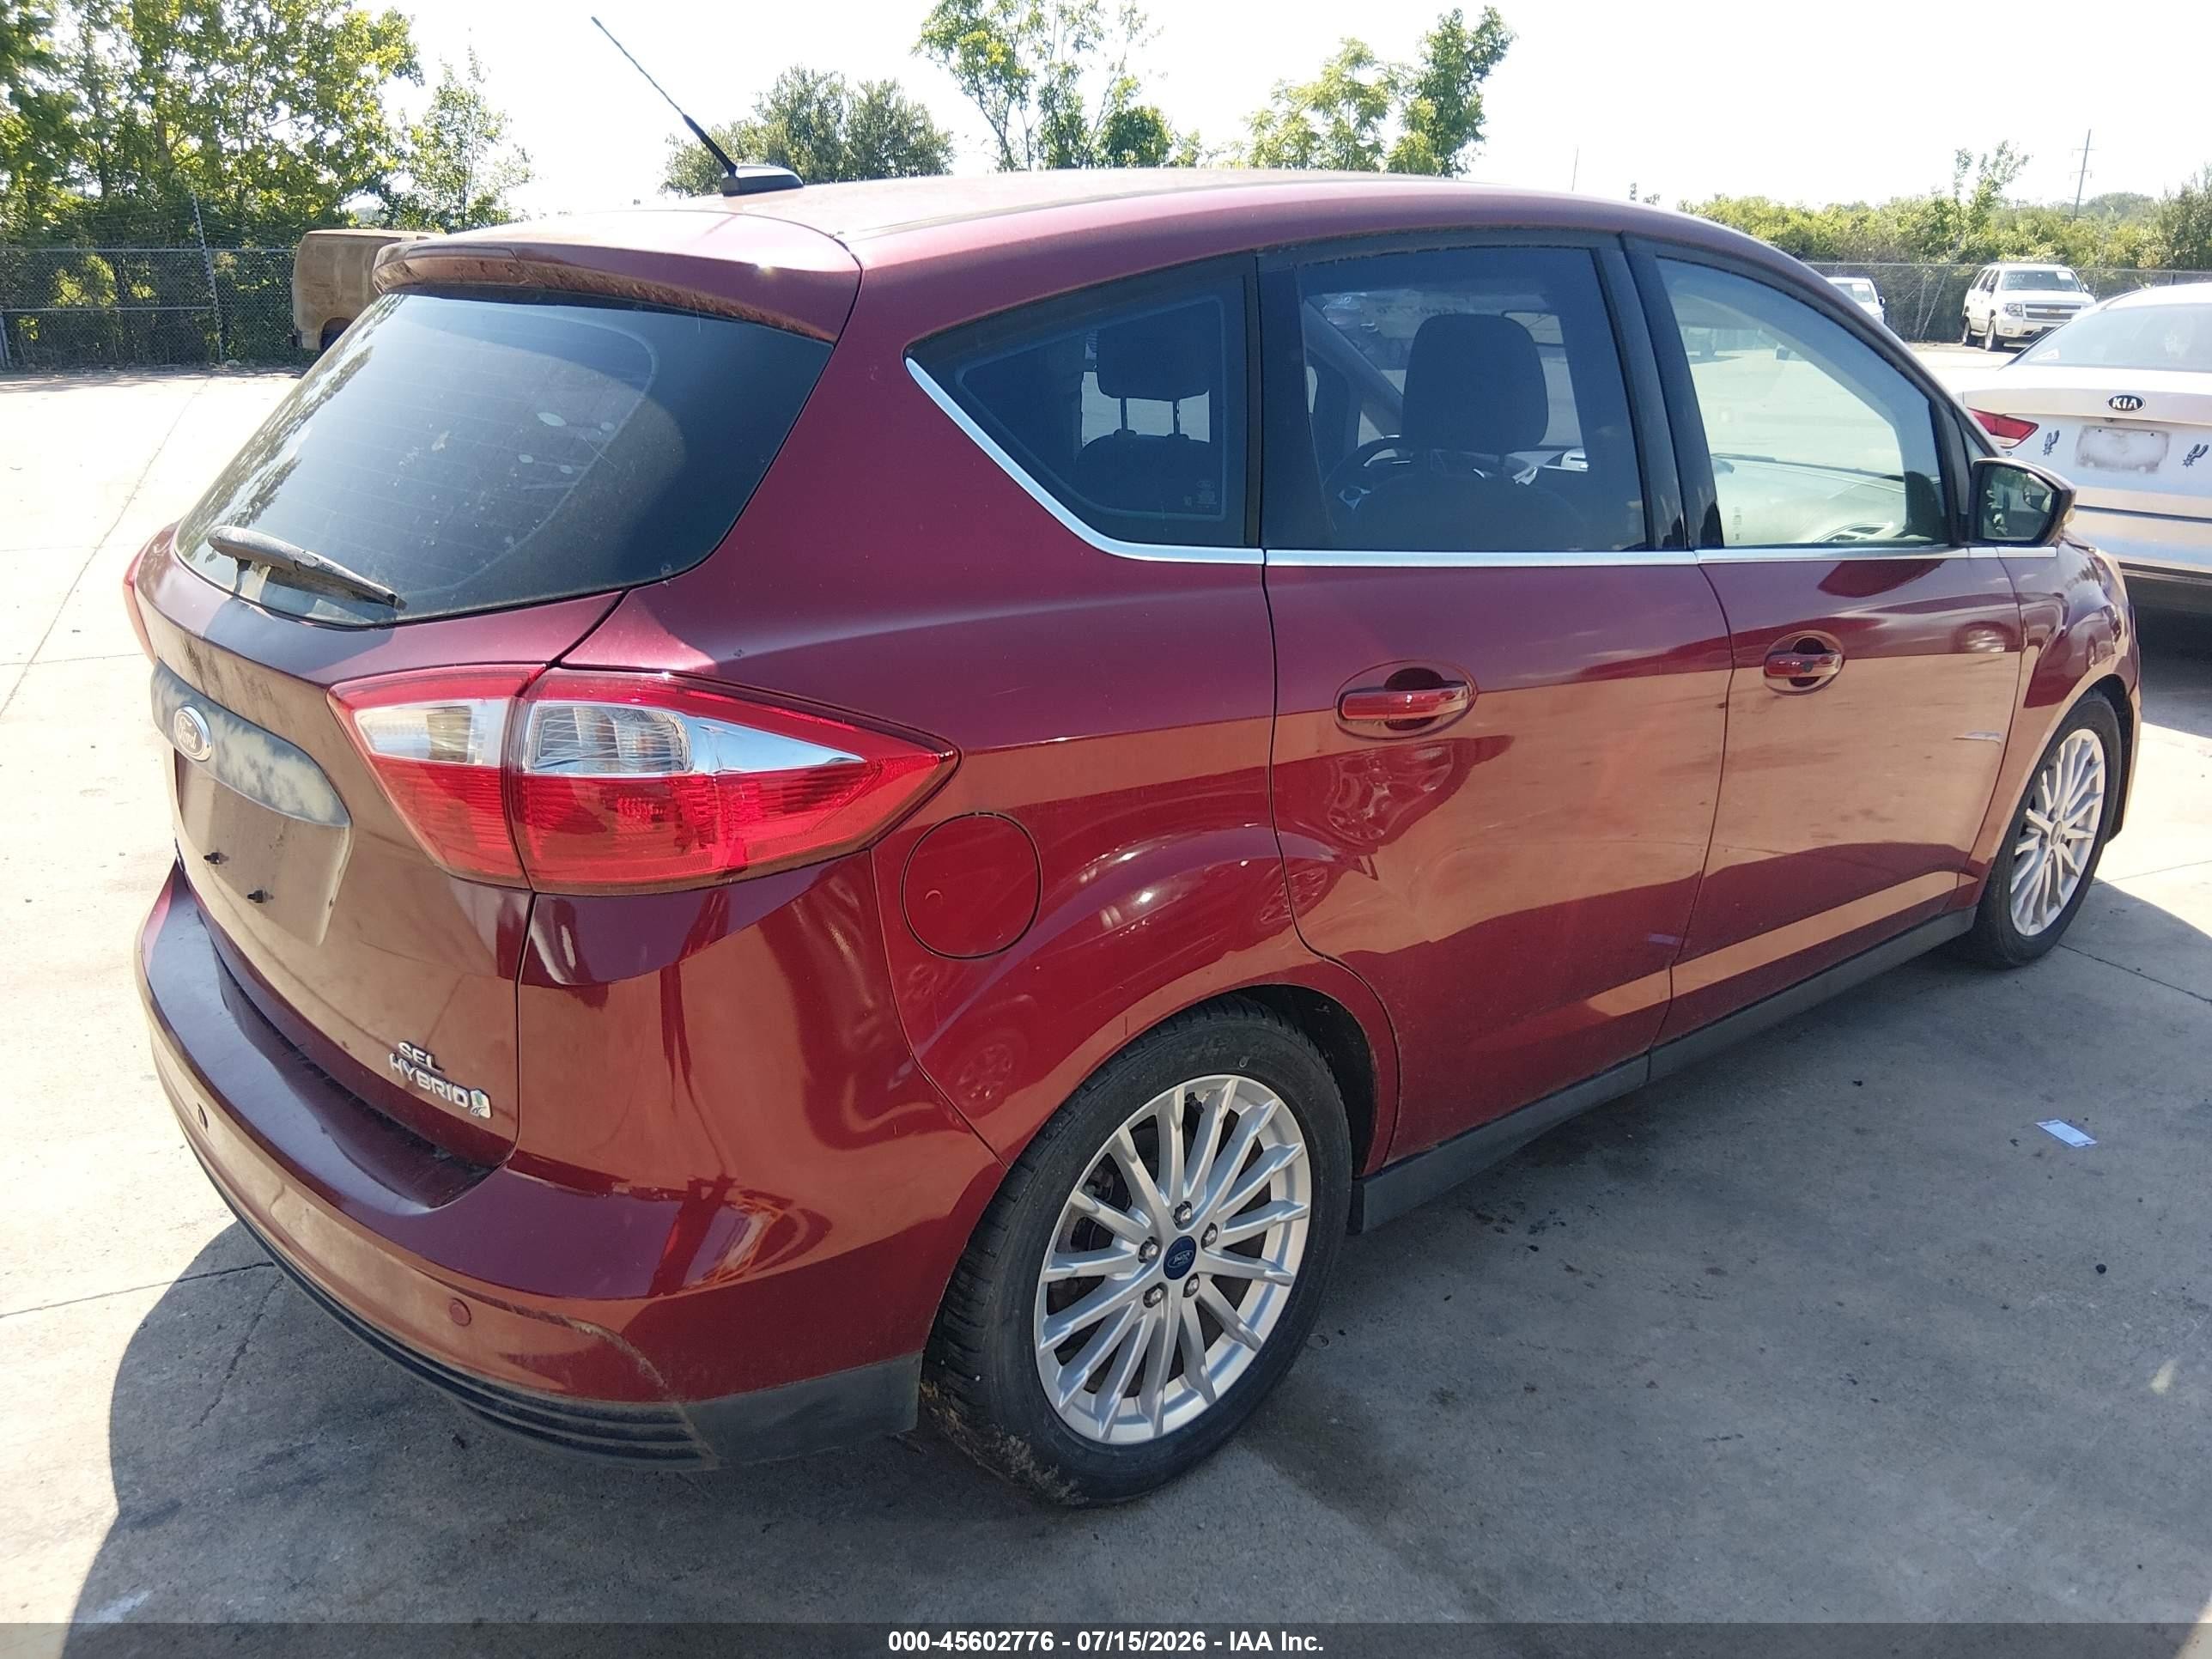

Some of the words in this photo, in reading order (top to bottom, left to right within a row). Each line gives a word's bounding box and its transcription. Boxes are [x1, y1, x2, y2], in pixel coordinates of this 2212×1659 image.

[2112, 397, 2138, 409] KIA
[178, 714, 198, 750] Ford
[398, 1041, 444, 1073] SEL
[388, 1052, 470, 1108] HYBRID
